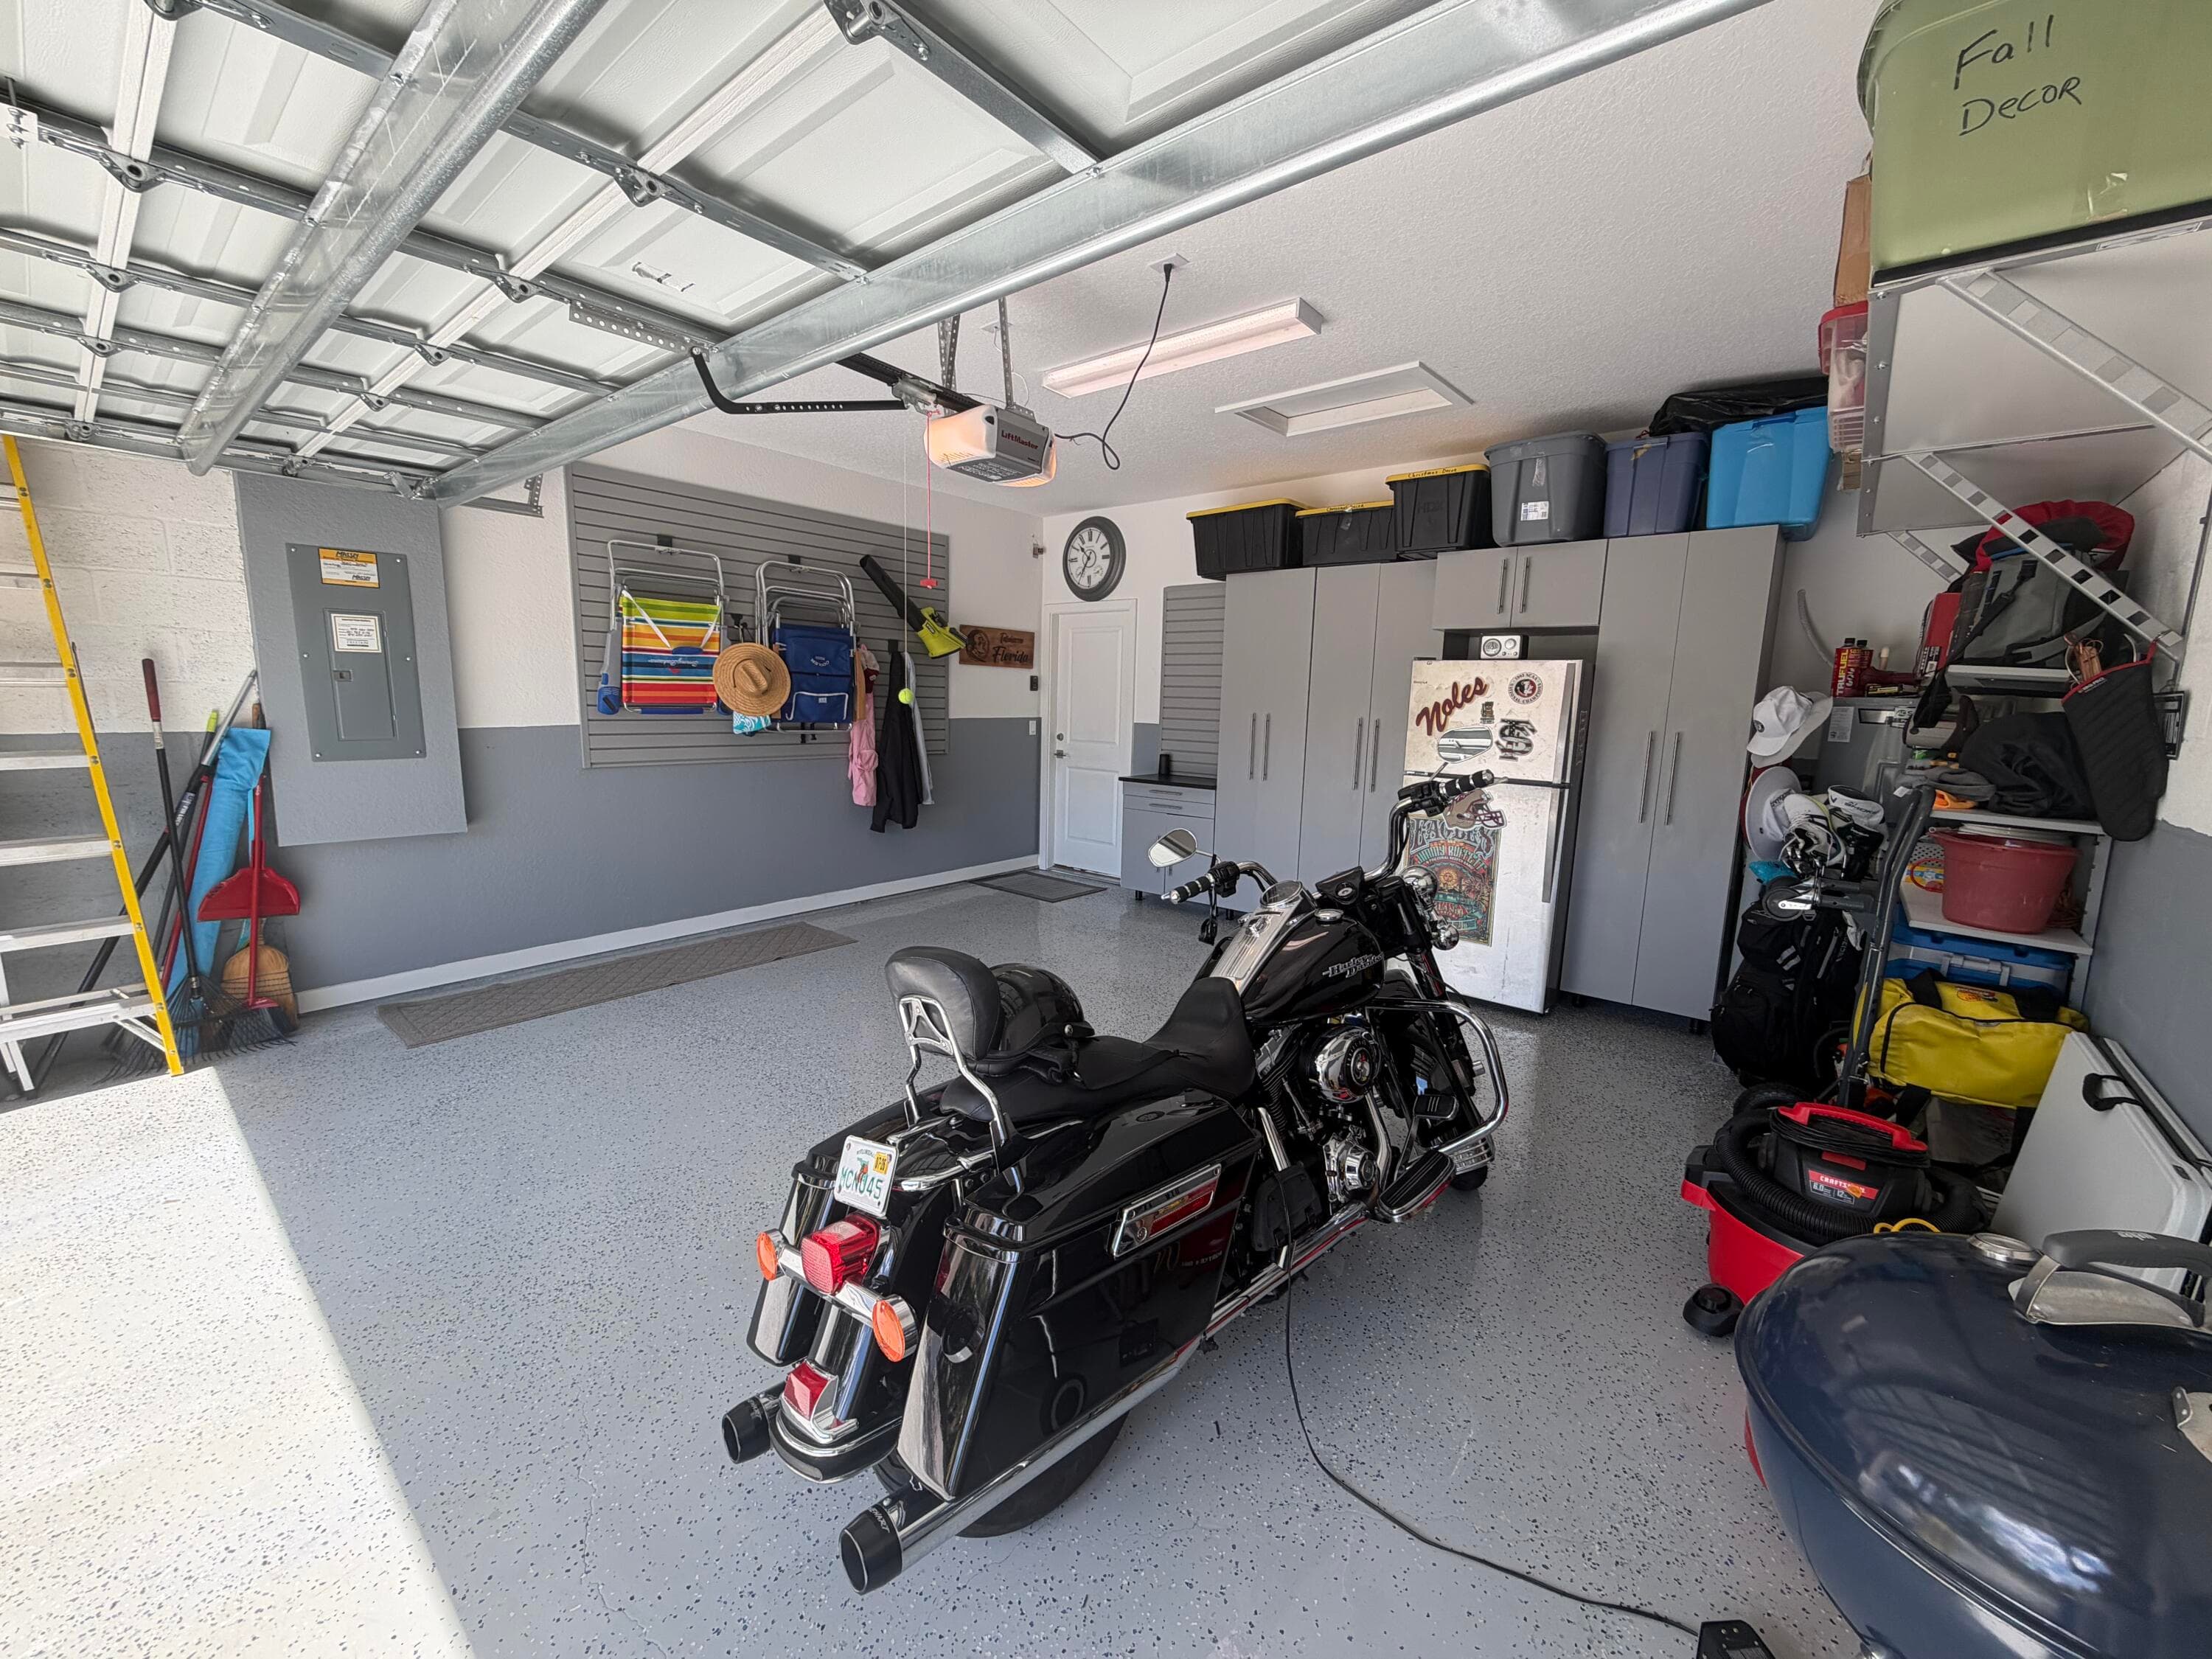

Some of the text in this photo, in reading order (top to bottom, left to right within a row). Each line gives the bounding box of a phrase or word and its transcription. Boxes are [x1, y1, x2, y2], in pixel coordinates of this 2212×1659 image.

[1954, 15, 2053, 90] Fall
[1001, 430, 1038, 450] LiftMaster
[992, 646, 1029, 663] Florida
[1836, 649, 1849, 696] TRUFUEL
[1416, 676, 1488, 736] Noles
[1416, 845, 1486, 871] JIMMY BUFFETT
[1820, 1175, 1865, 1194] CRAFTSN
